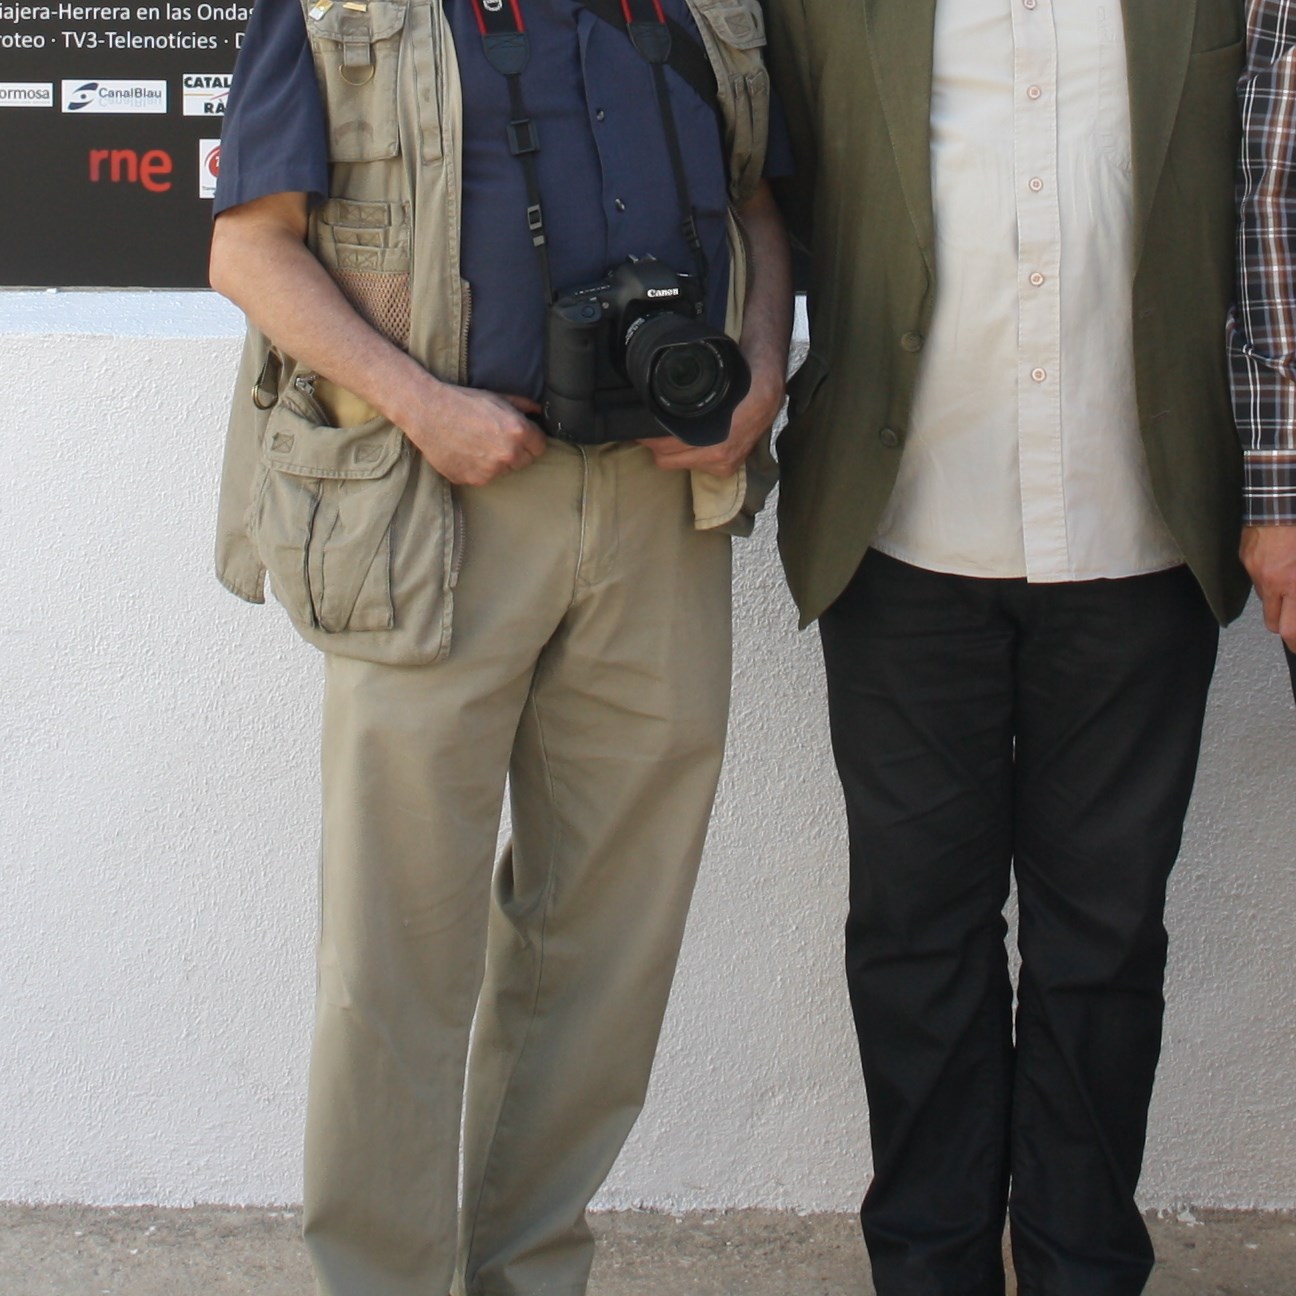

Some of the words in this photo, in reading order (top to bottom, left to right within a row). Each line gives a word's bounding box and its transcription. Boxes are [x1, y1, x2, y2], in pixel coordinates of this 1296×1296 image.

[136, 7, 160, 21] en
[166, 2, 192, 21] las
[61, 30, 218, 50] TV3-Telenotícies
[184, 76, 231, 89] CATAL
[99, 87, 163, 99] CanalBlau
[89, 148, 173, 193] rne
[646, 287, 680, 298] Canon
